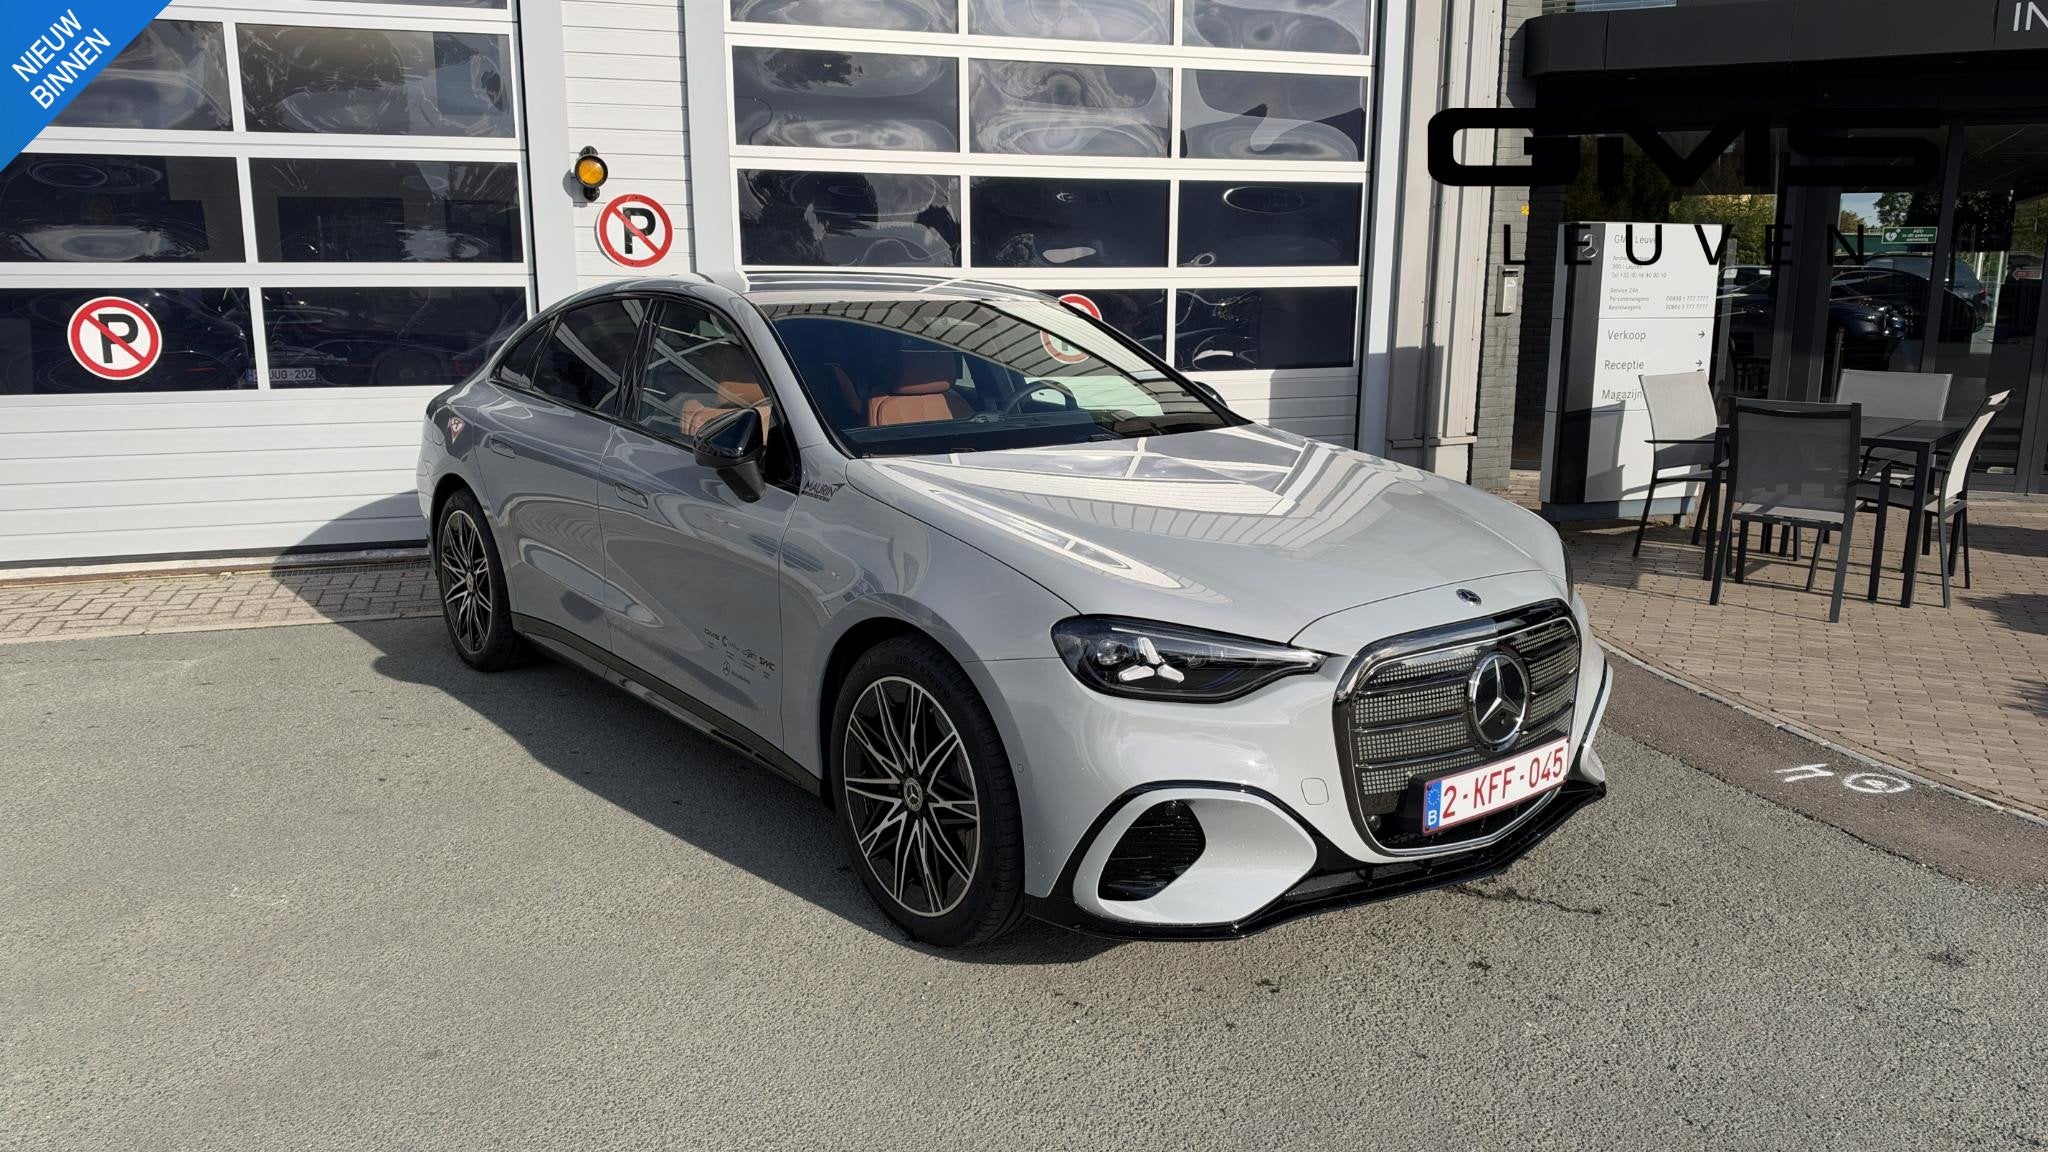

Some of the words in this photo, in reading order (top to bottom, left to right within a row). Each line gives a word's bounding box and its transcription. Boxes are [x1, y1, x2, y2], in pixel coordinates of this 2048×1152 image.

[1607, 329, 1647, 342] Verkoop
[1604, 360, 1645, 372] Receptie
[1601, 389, 1642, 401] Magazijn
[1427, 809, 1438, 825] B
[1442, 747, 1564, 819] 2-KFF-045
